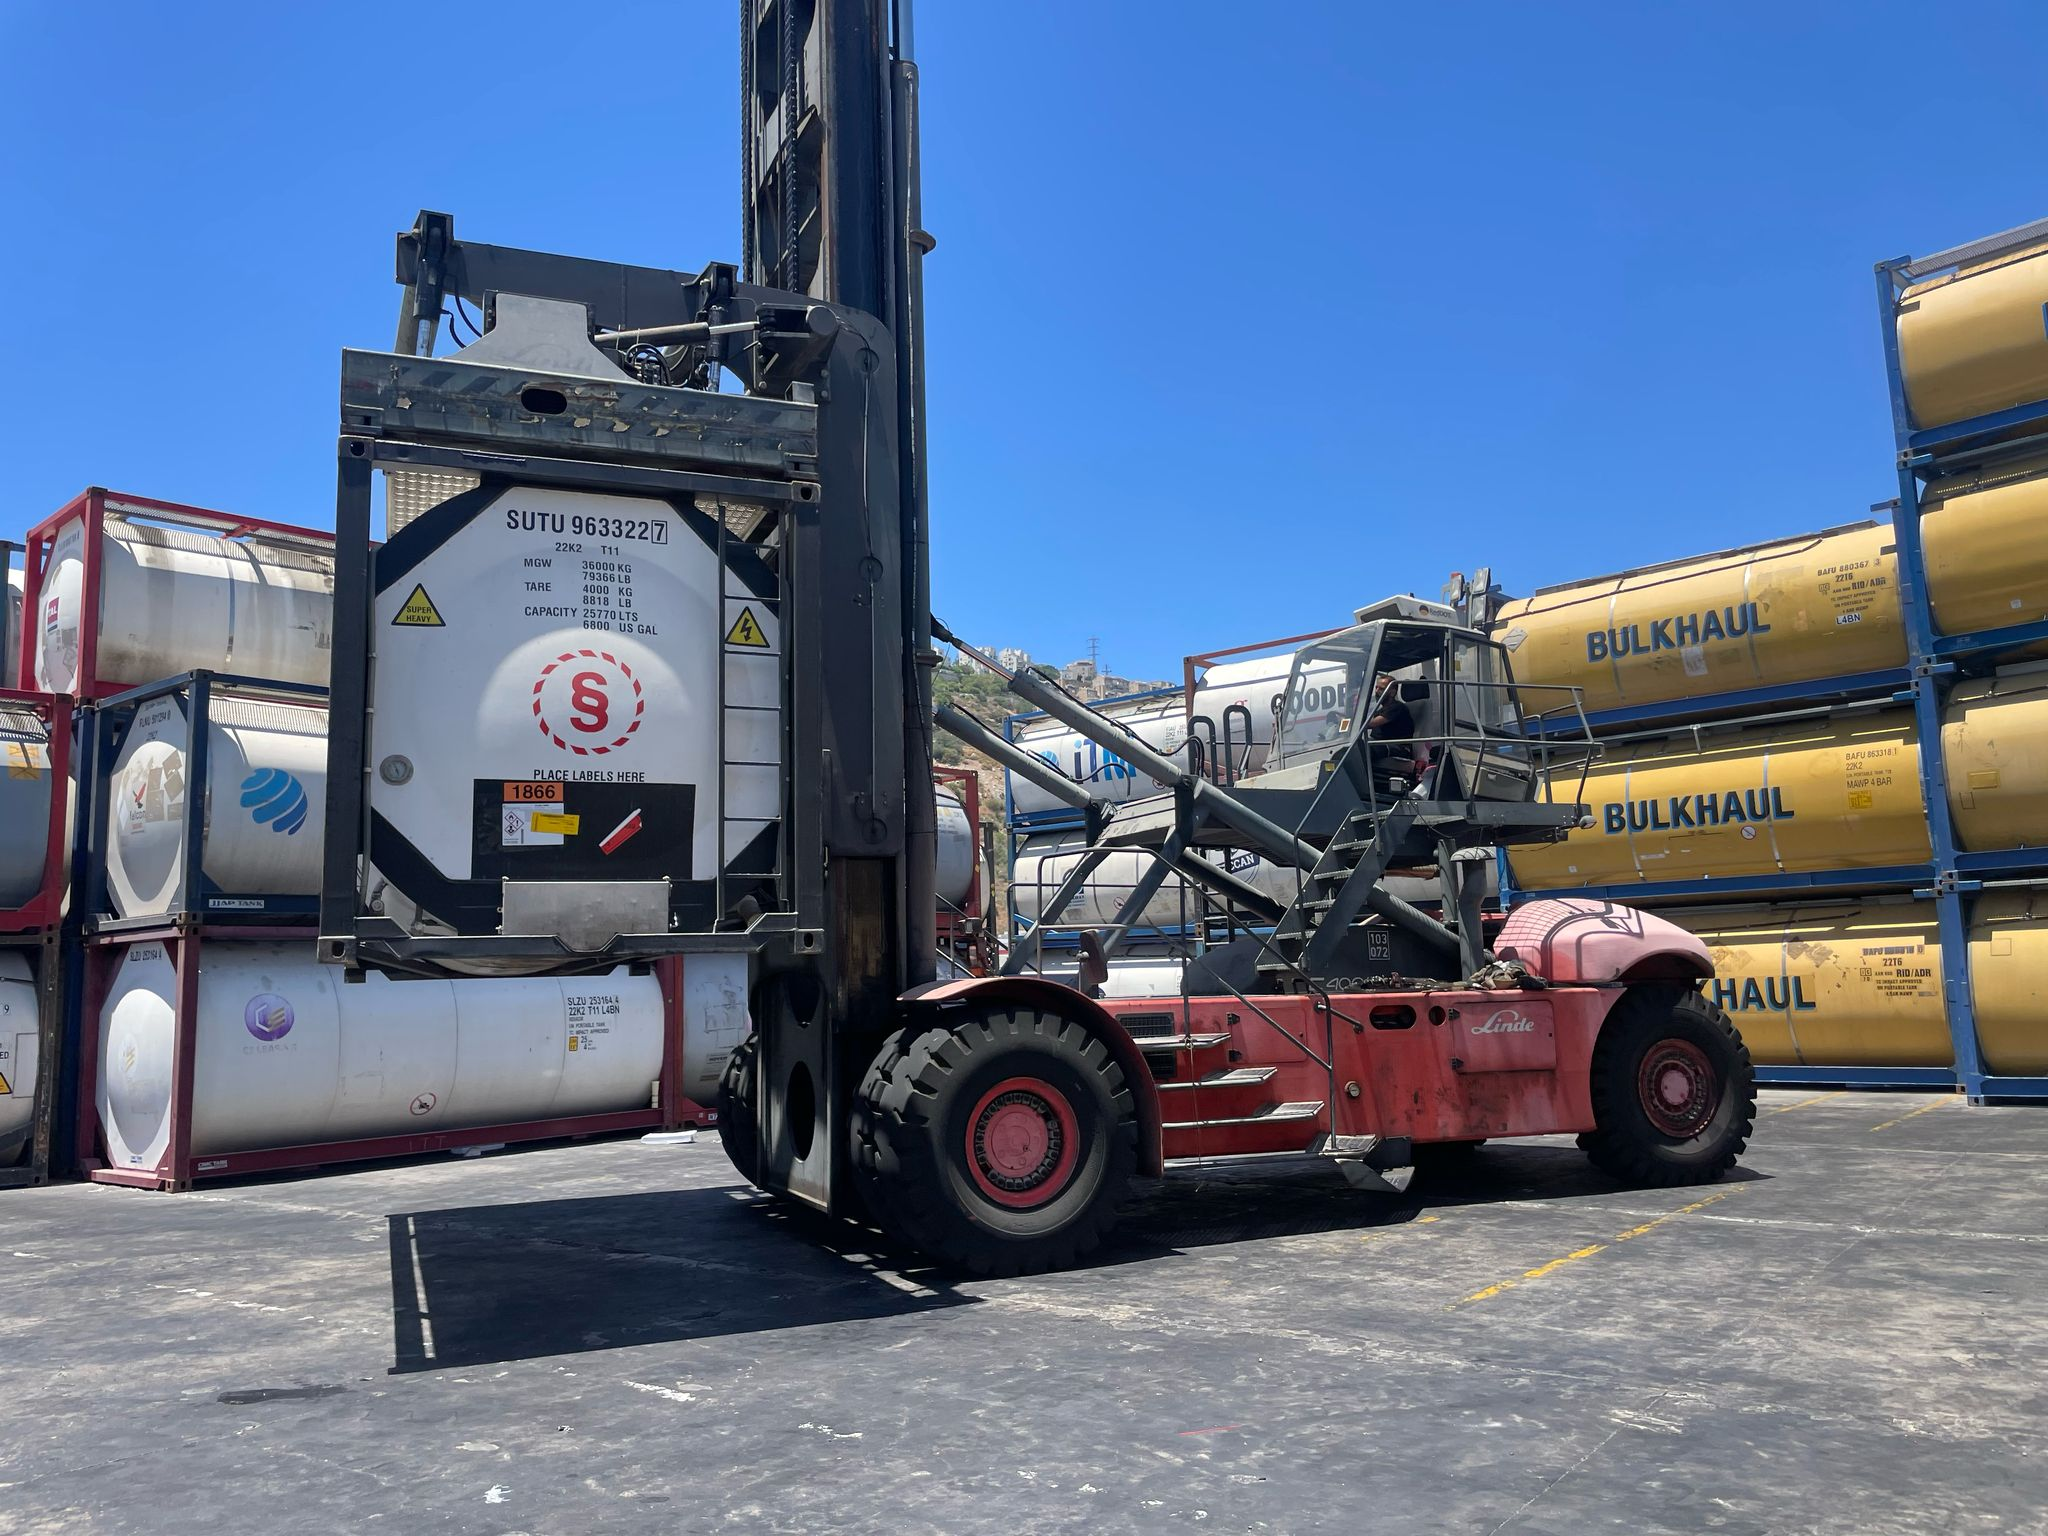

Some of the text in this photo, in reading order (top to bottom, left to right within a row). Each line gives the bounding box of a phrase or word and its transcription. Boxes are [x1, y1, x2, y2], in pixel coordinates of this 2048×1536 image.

[506, 509, 565, 533] SUTU
[571, 515, 649, 541] 963322
[555, 542, 619, 556] 22K2 T11
[524, 558, 632, 573] MGW 36000 KG
[583, 571, 631, 584] 79366 LB
[1817, 567, 1837, 577] BAFU
[1835, 573, 1854, 583] 22T6
[525, 582, 633, 597] TARE 4000 KG
[583, 595, 632, 608] 8818 LB
[406, 605, 432, 613] SUPER
[524, 606, 638, 622] CAPACITY 25770 LTS
[1836, 613, 1861, 625] L4BN
[583, 620, 658, 635] 6800 US GAL
[1587, 602, 1771, 664] BULKHAUL
[1846, 752, 1865, 760] BAFU
[1846, 762, 1863, 771] 22K2
[533, 769, 645, 783] PLACE LABELS HERE
[1847, 777, 1892, 788] MAWP 4 BAR
[512, 784, 556, 799] 1866
[1604, 787, 1795, 835] BULKHAUL
[238, 900, 264, 908] TANK
[1370, 933, 1387, 945] 103
[1370, 946, 1388, 958] 072
[1883, 958, 1902, 966] 22T6
[1896, 969, 1931, 977] RID/ADR
[1704, 976, 1816, 1011] HAUL
[567, 997, 587, 1006] SLZU
[589, 996, 613, 1005] 253164
[4, 1005, 10, 1014] 9
[569, 1005, 620, 1016] 22K2 T11 L4BN
[1471, 1009, 1535, 1034] Linde
[581, 1036, 588, 1044] 25
